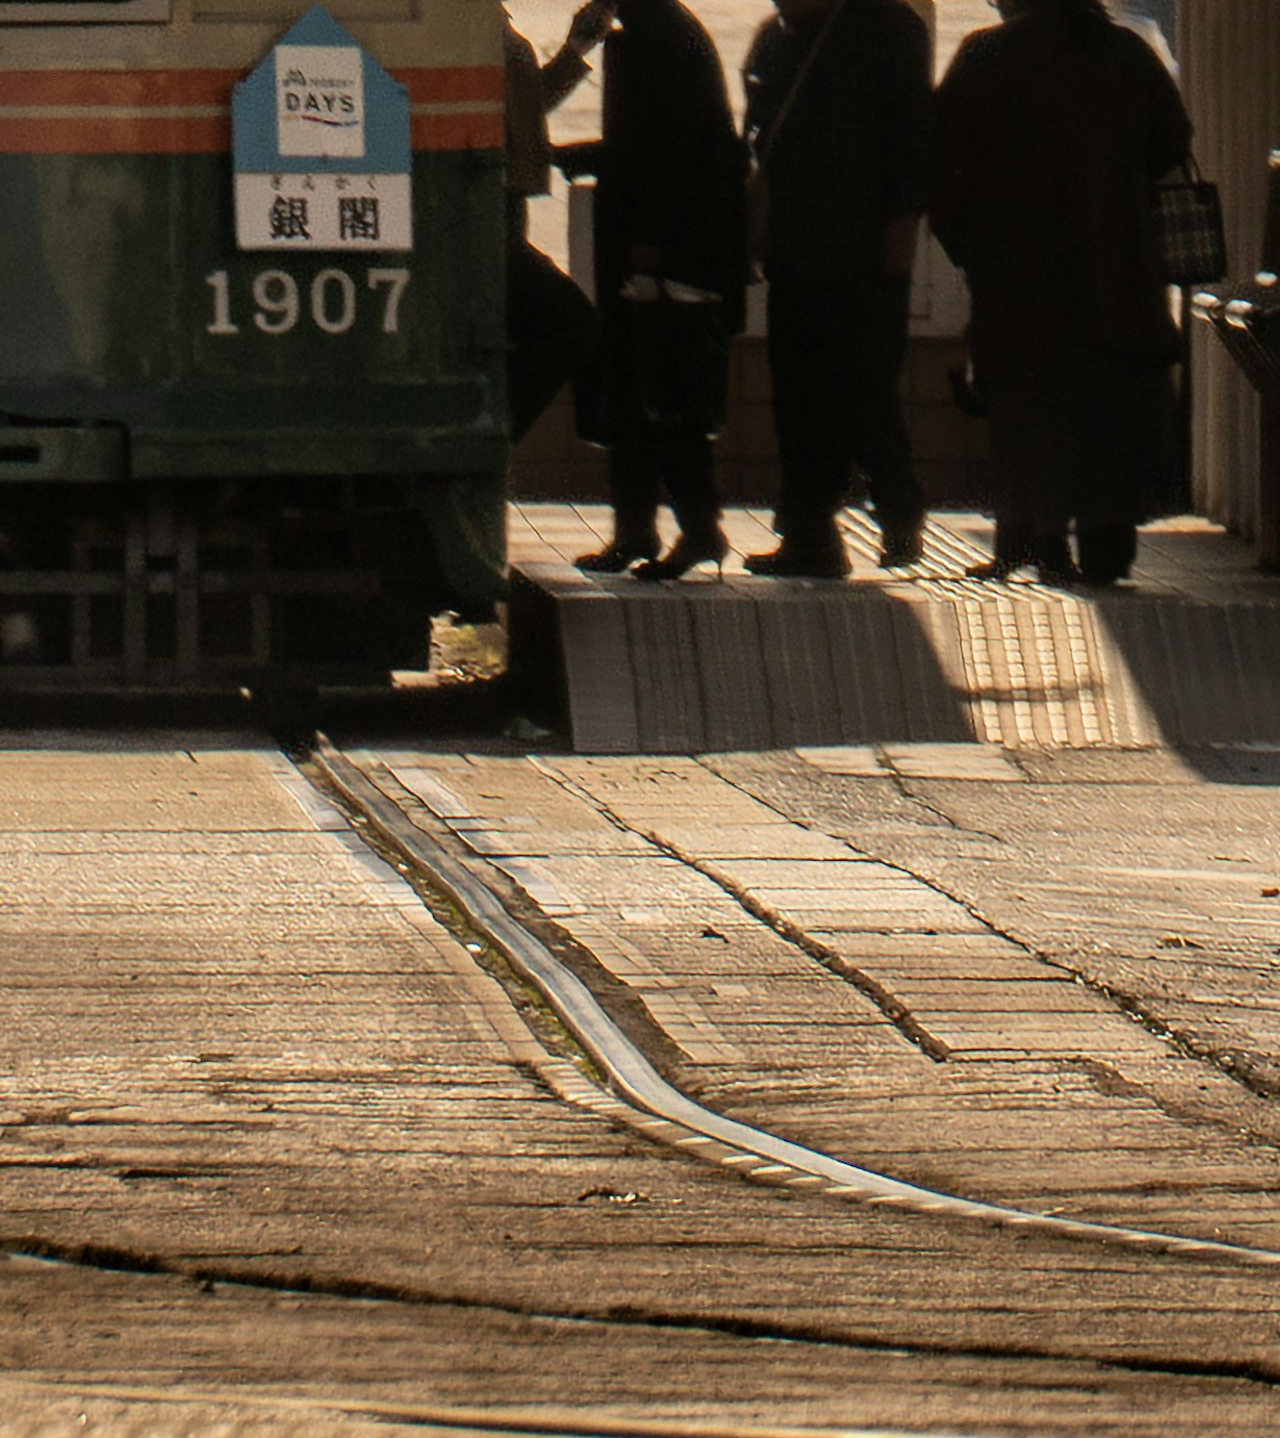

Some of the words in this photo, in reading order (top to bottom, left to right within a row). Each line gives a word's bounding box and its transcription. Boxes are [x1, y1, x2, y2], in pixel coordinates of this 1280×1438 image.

[286, 92, 355, 115] DAYS
[271, 196, 381, 241] 銀閣
[205, 268, 411, 335] 1907
